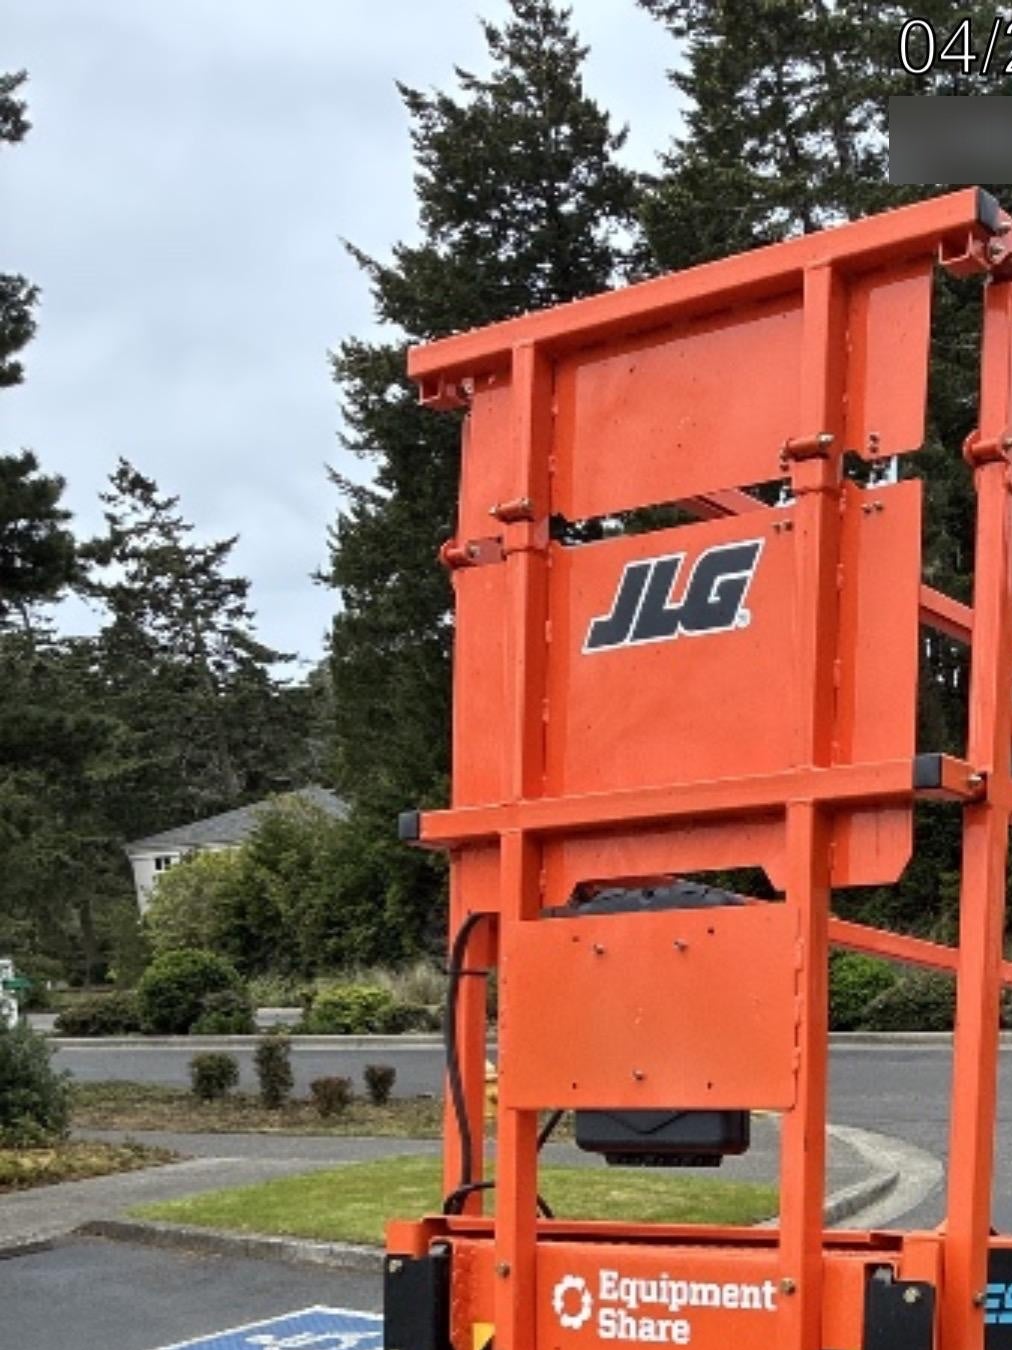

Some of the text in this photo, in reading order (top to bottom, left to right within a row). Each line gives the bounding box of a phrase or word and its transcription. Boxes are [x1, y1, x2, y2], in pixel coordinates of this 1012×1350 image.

[581, 537, 766, 655] JLG
[599, 1269, 777, 1312] Equipment
[598, 1307, 691, 1345] Share
